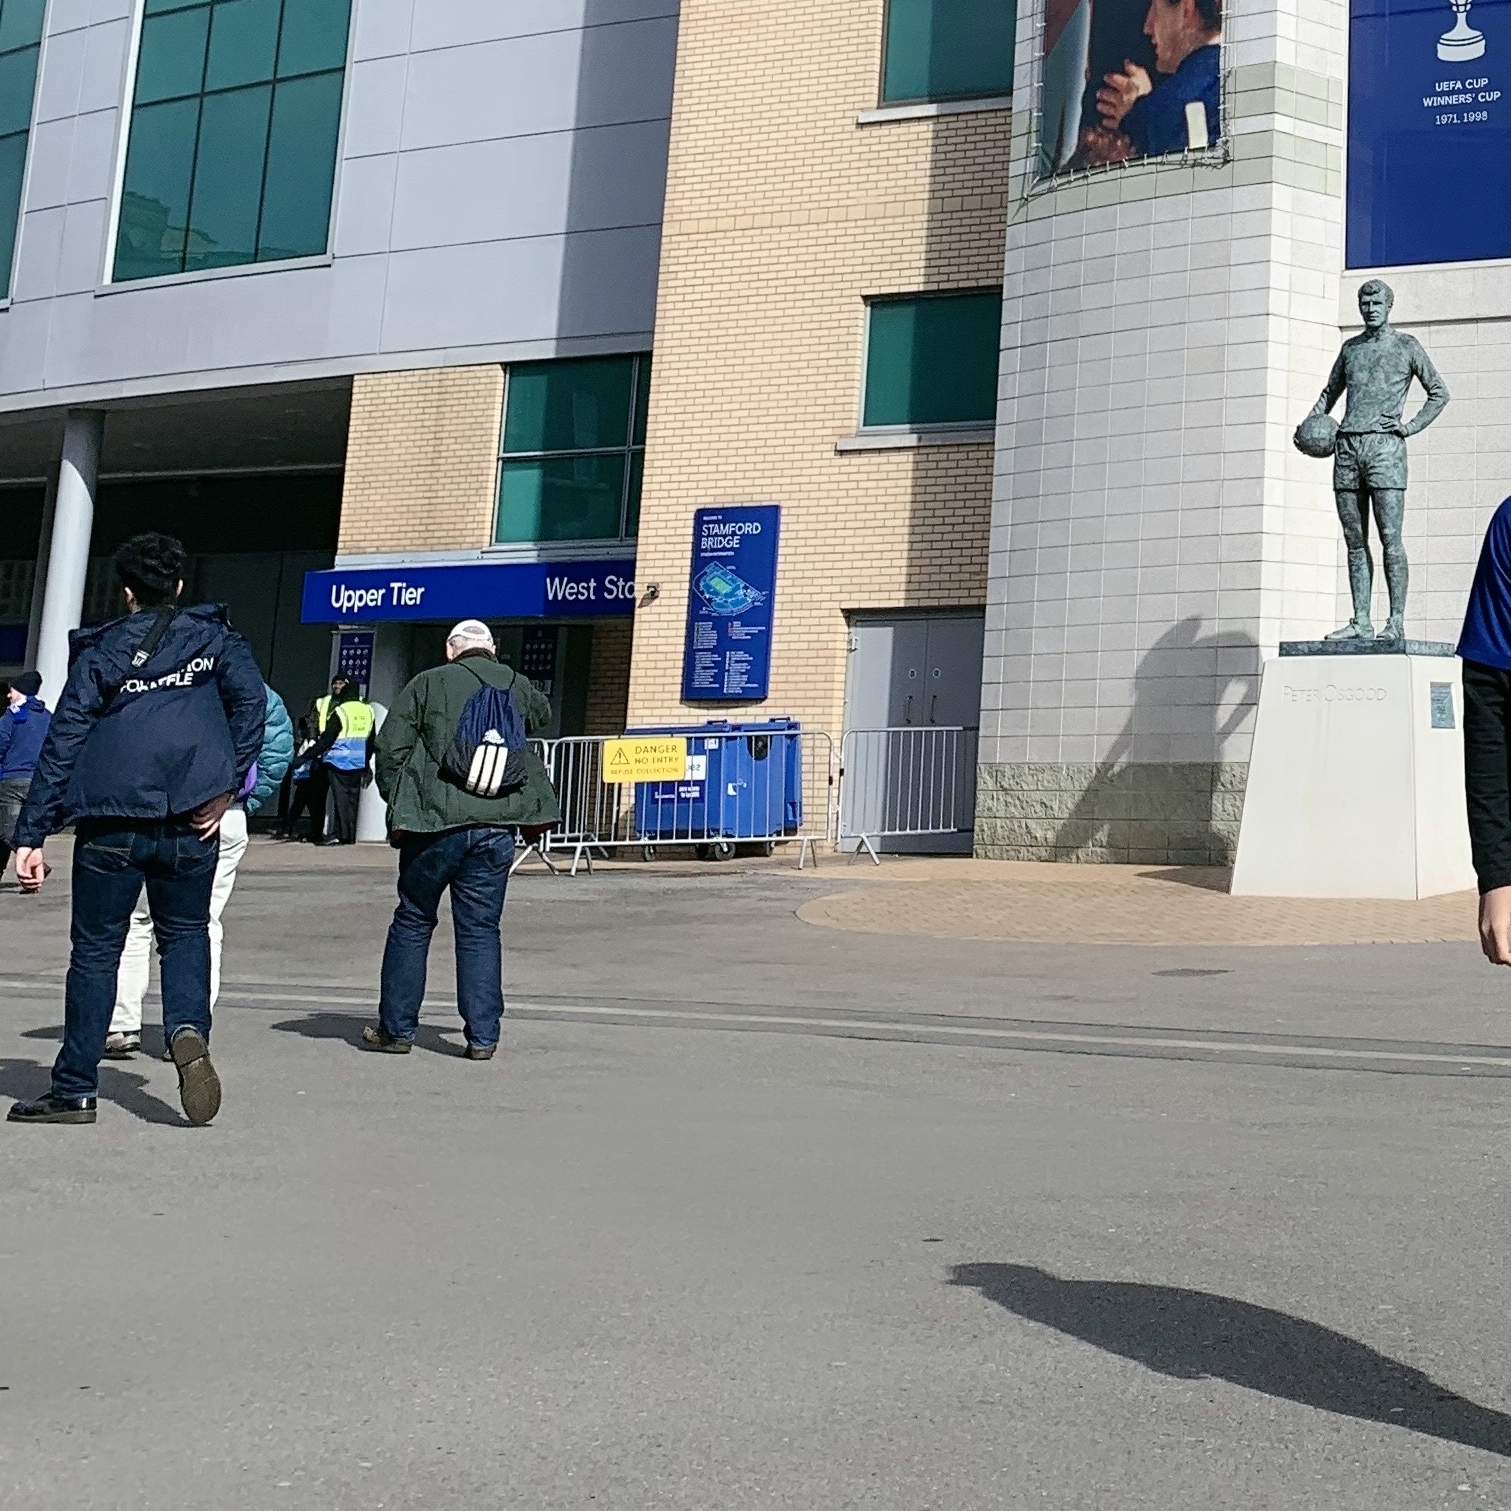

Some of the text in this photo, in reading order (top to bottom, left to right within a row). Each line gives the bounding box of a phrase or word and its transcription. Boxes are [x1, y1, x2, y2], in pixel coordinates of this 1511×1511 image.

[1435, 78, 1489, 92] UEFA CUP
[1478, 90, 1501, 103] CUP
[1463, 110, 1488, 123] 1998
[701, 522, 762, 536] STAMFORD
[701, 536, 740, 549] BRIDGE
[546, 577, 597, 601] West
[331, 582, 425, 613] Upper Tier
[635, 745, 678, 754] DANGER
[635, 756, 679, 765] NO ENTRY
[636, 767, 679, 775] COLLECTION
